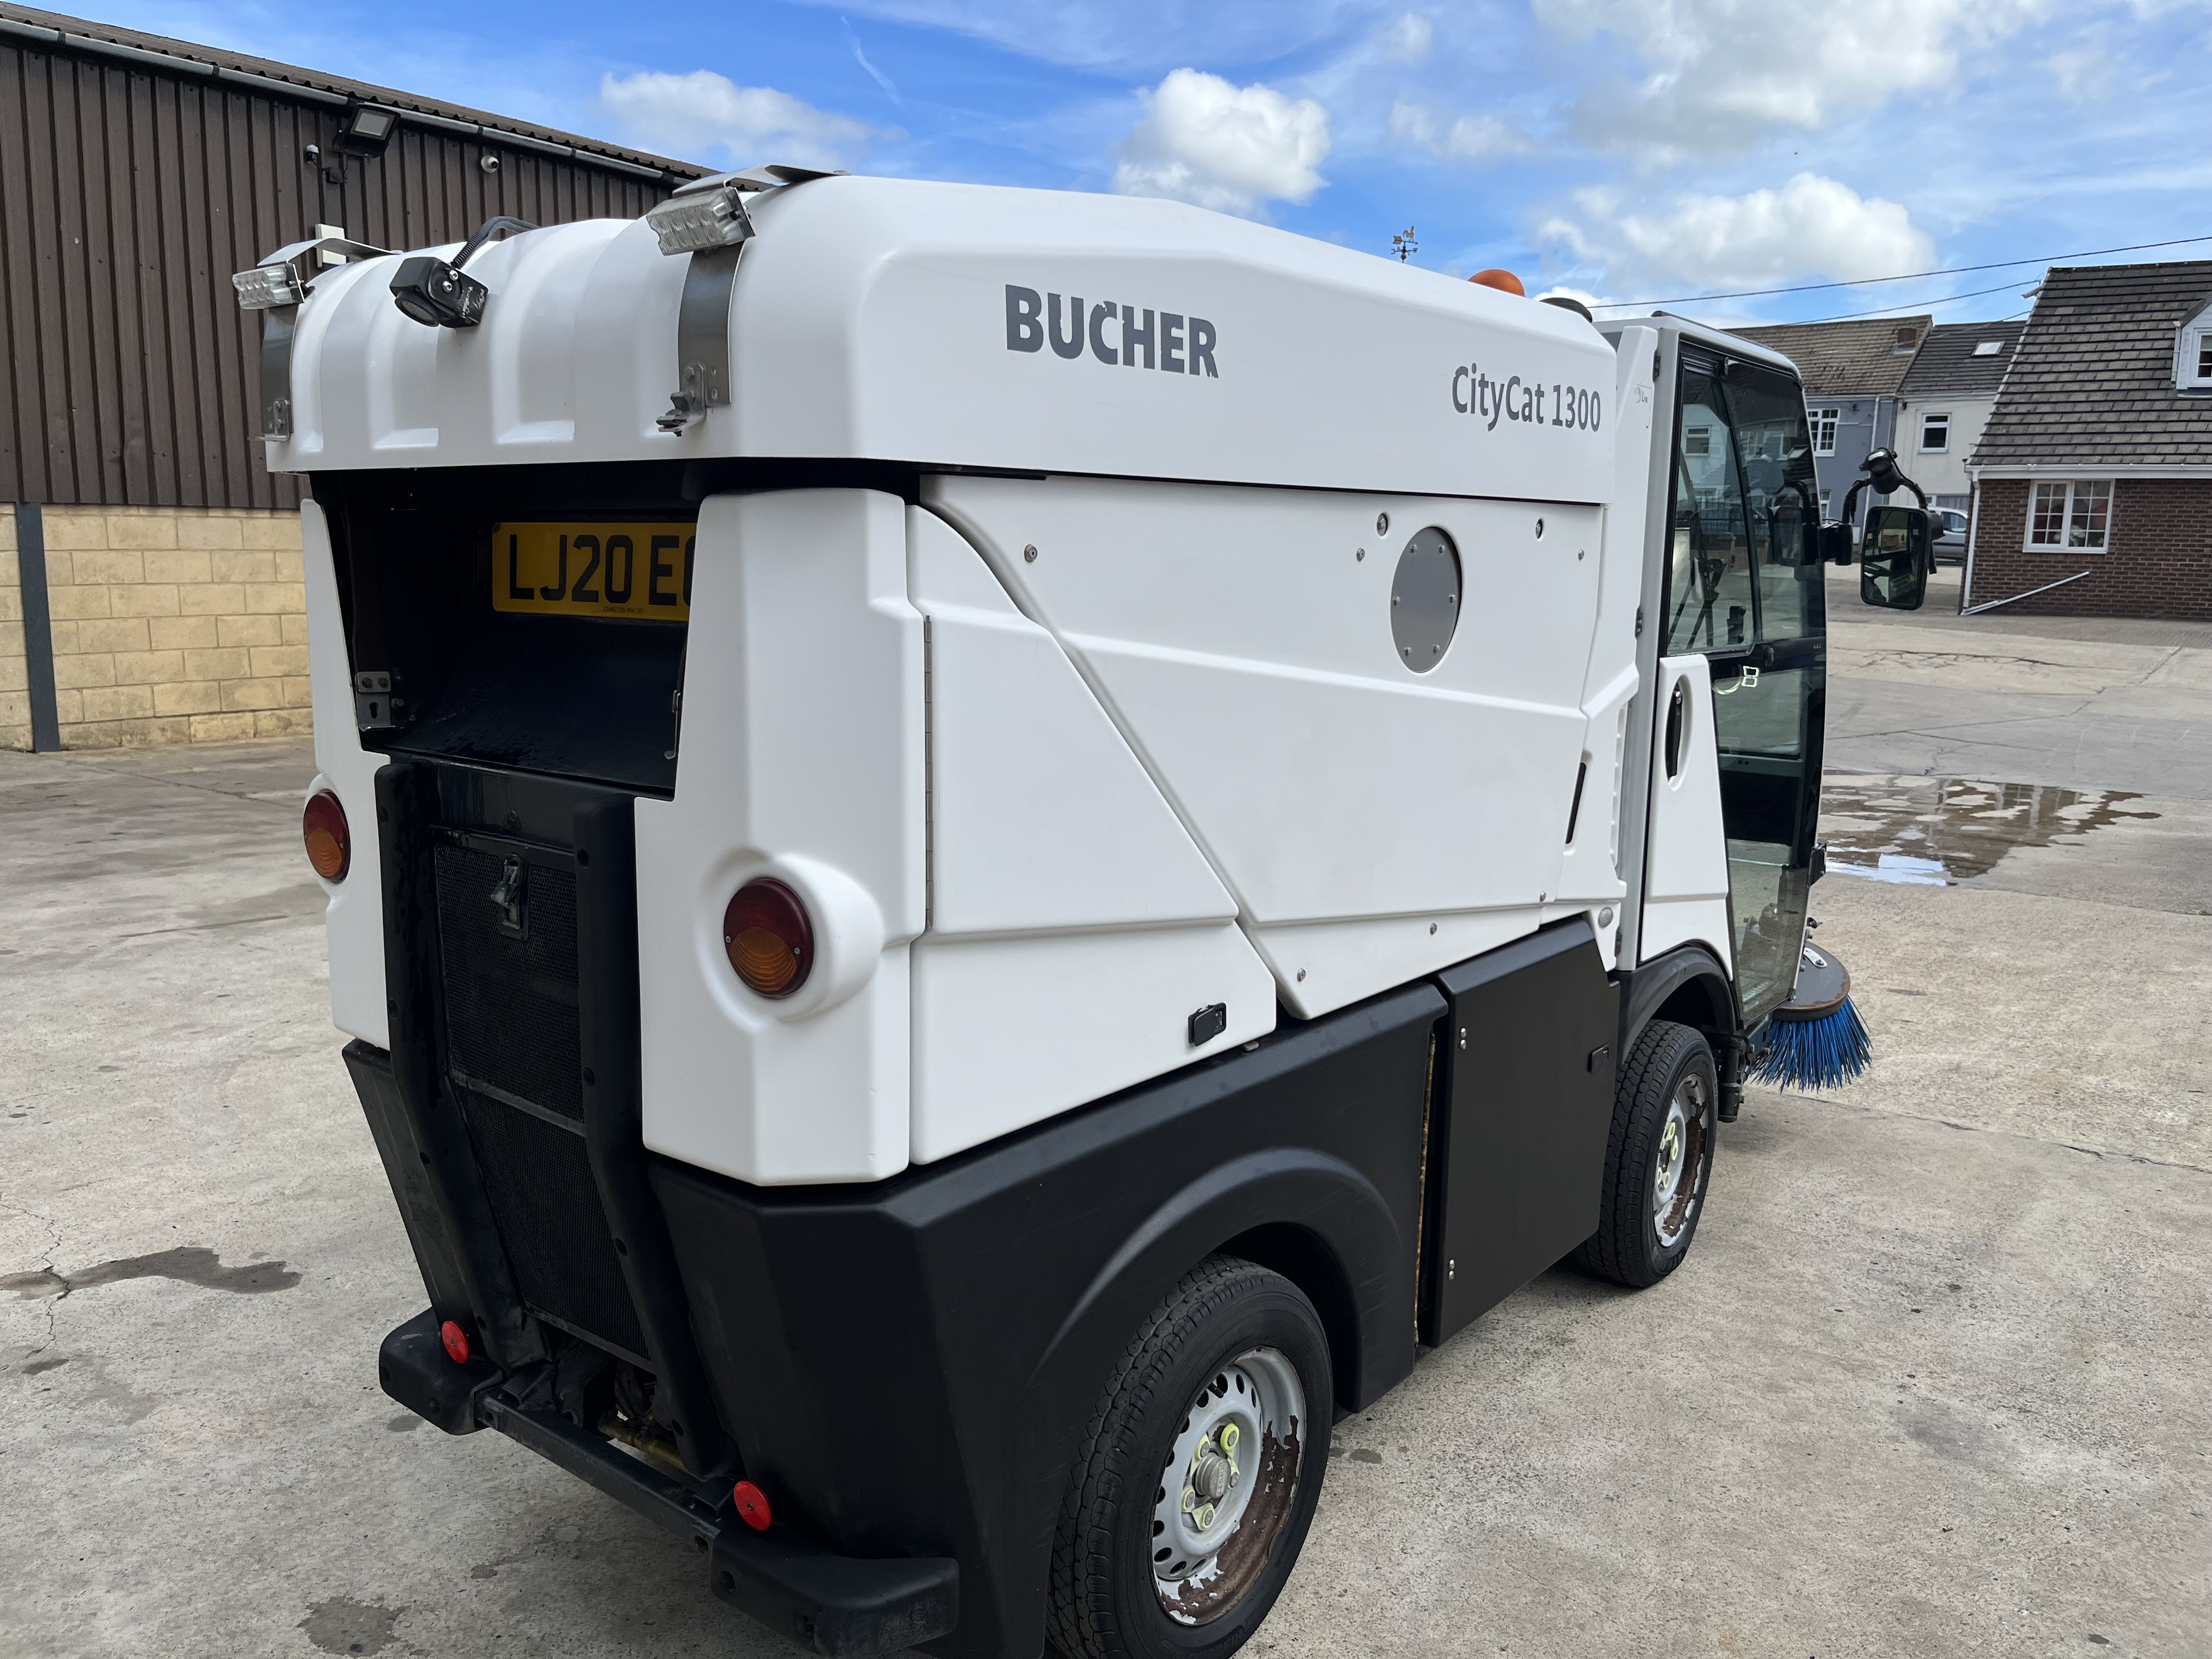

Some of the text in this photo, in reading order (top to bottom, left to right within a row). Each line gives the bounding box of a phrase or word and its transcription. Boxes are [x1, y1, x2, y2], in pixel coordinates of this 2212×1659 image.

[1005, 284, 1219, 379] BUCHER
[1452, 363, 1601, 432] CityCat 1300
[509, 533, 634, 604] LJ20
